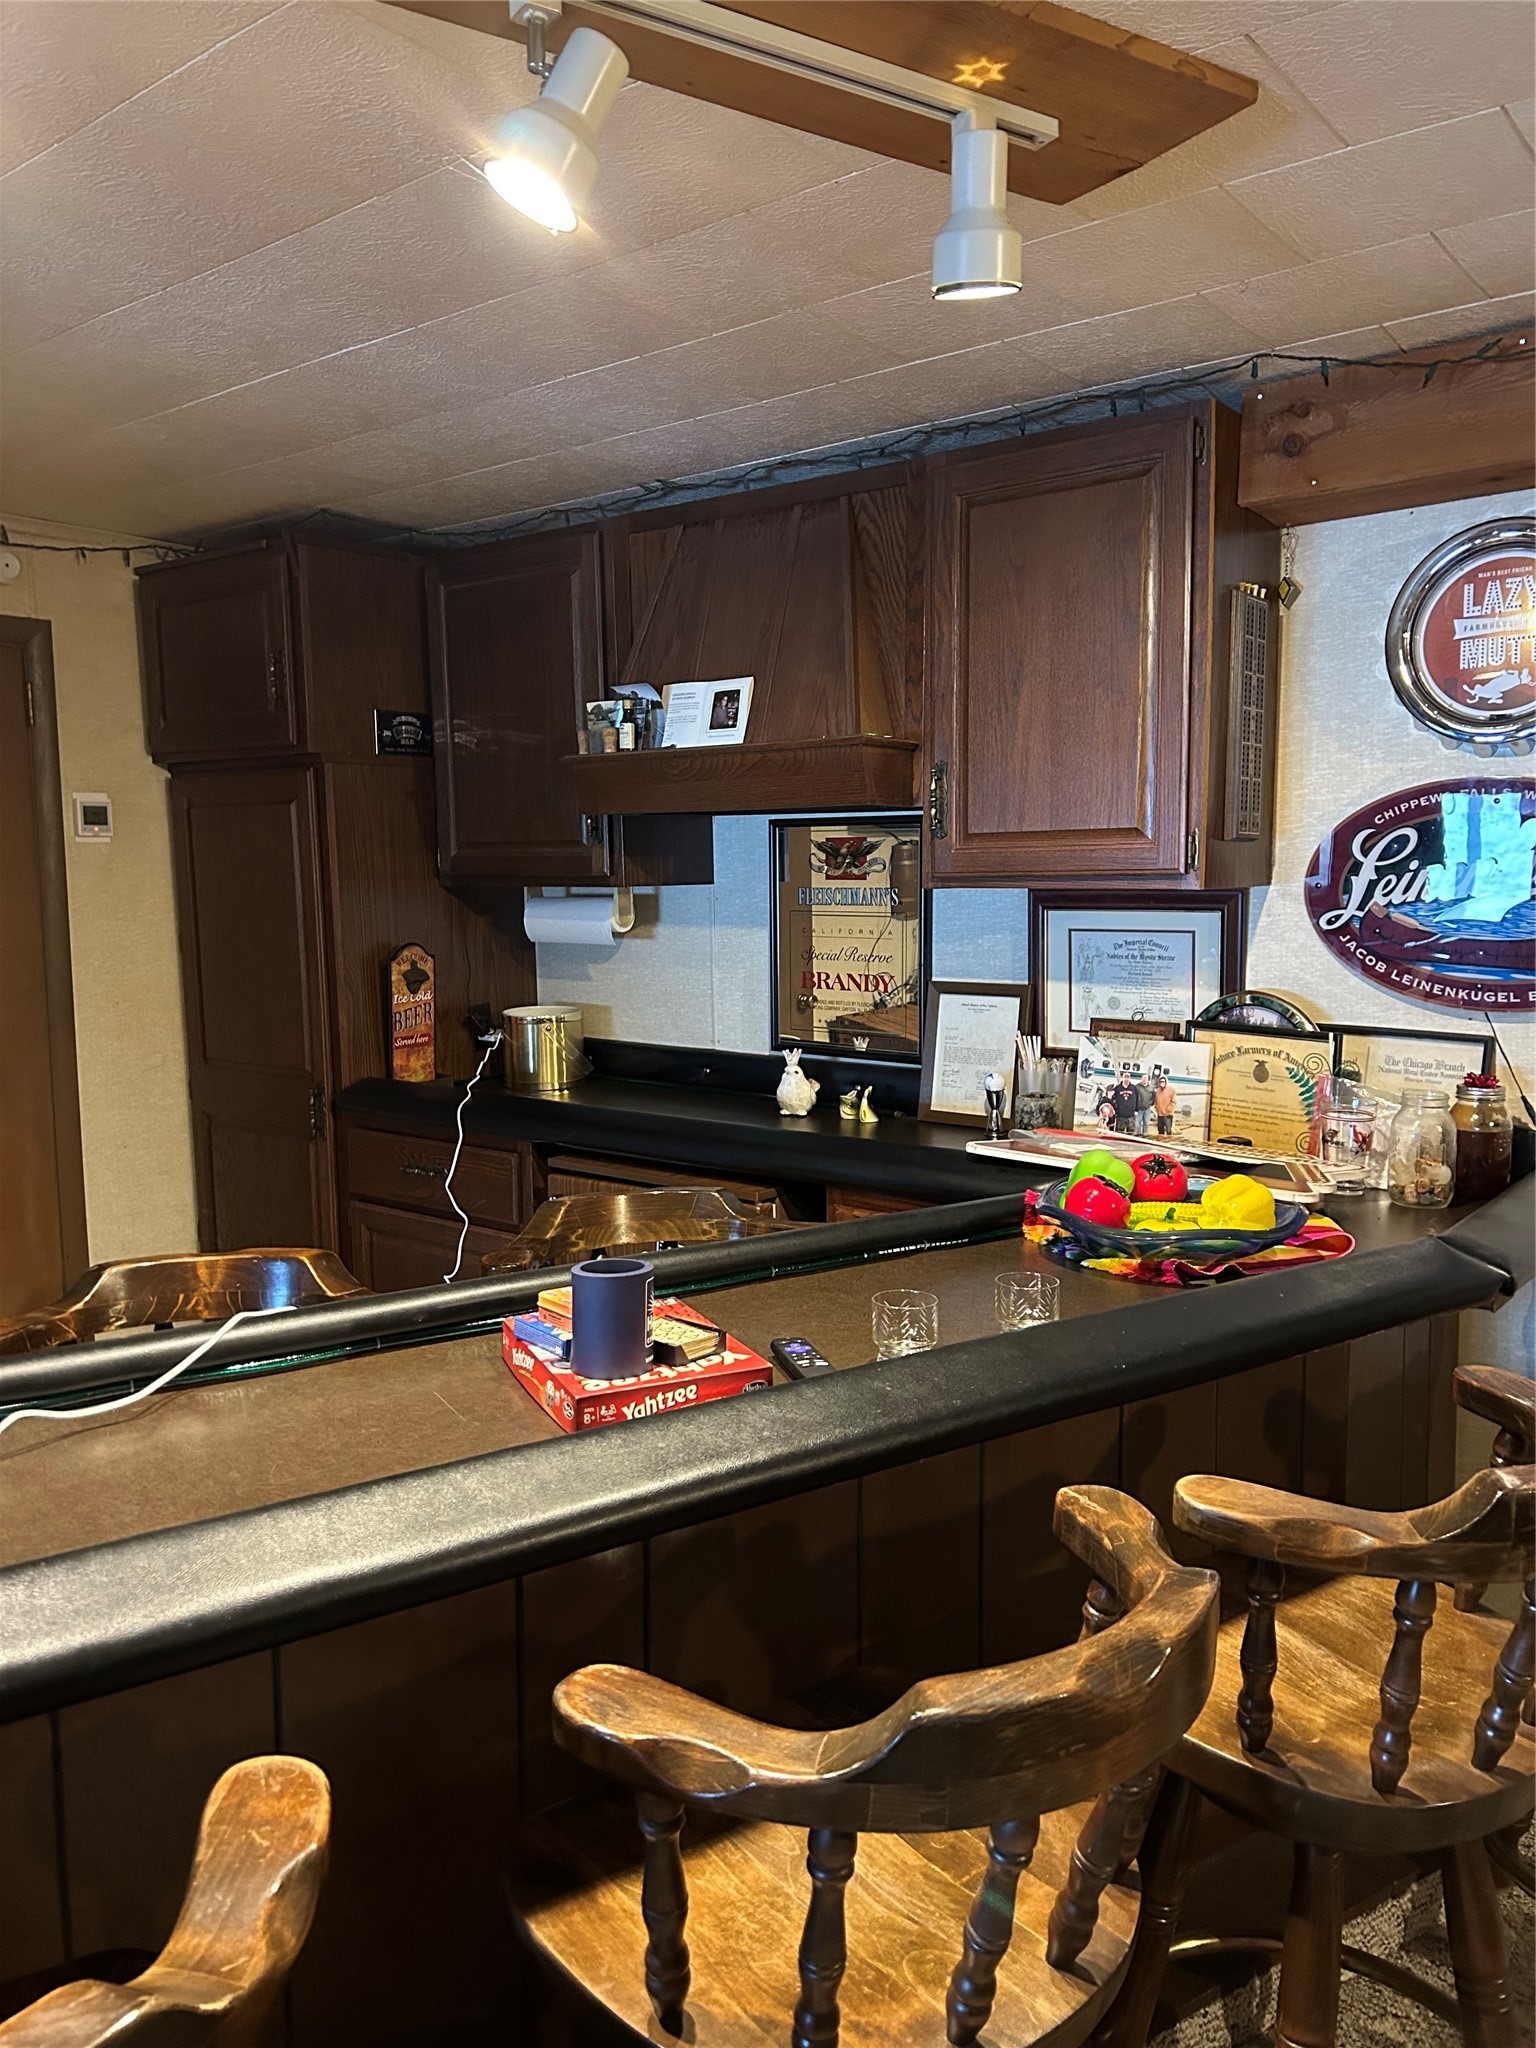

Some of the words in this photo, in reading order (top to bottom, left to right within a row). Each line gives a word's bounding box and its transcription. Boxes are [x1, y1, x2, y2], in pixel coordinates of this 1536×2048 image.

[1478, 571, 1496, 579] MAN'S
[1512, 566, 1533, 574] FRIEND
[1463, 575, 1536, 617] LAZY
[1460, 634, 1536, 670] MUTT
[1374, 791, 1456, 824] CHIPPEW
[798, 887, 899, 906] FLEISCHMANN'S
[802, 928, 893, 936] CALIFORNIA
[801, 945, 844, 966] Special
[844, 947, 894, 963] Reserve
[1148, 940, 1169, 952] Council
[1339, 934, 1387, 973] JACOB
[1391, 969, 1521, 1003] LEINENKUGEL
[801, 970, 895, 993] BRANDY
[394, 994, 409, 1004] Ice
[410, 990, 434, 1002] Cold
[393, 1002, 432, 1032] BEER
[395, 1034, 417, 1047] Served
[417, 1033, 429, 1044] here
[1215, 1050, 1236, 1065] uture
[1235, 1046, 1272, 1057] Farmers
[1273, 1049, 1284, 1058] of
[1384, 1055, 1401, 1066] The
[1403, 1057, 1433, 1069] Chicago
[1434, 1059, 1466, 1073] Branch
[512, 1347, 535, 1371] Yahtzee
[621, 1385, 698, 1421] Yahtzee
